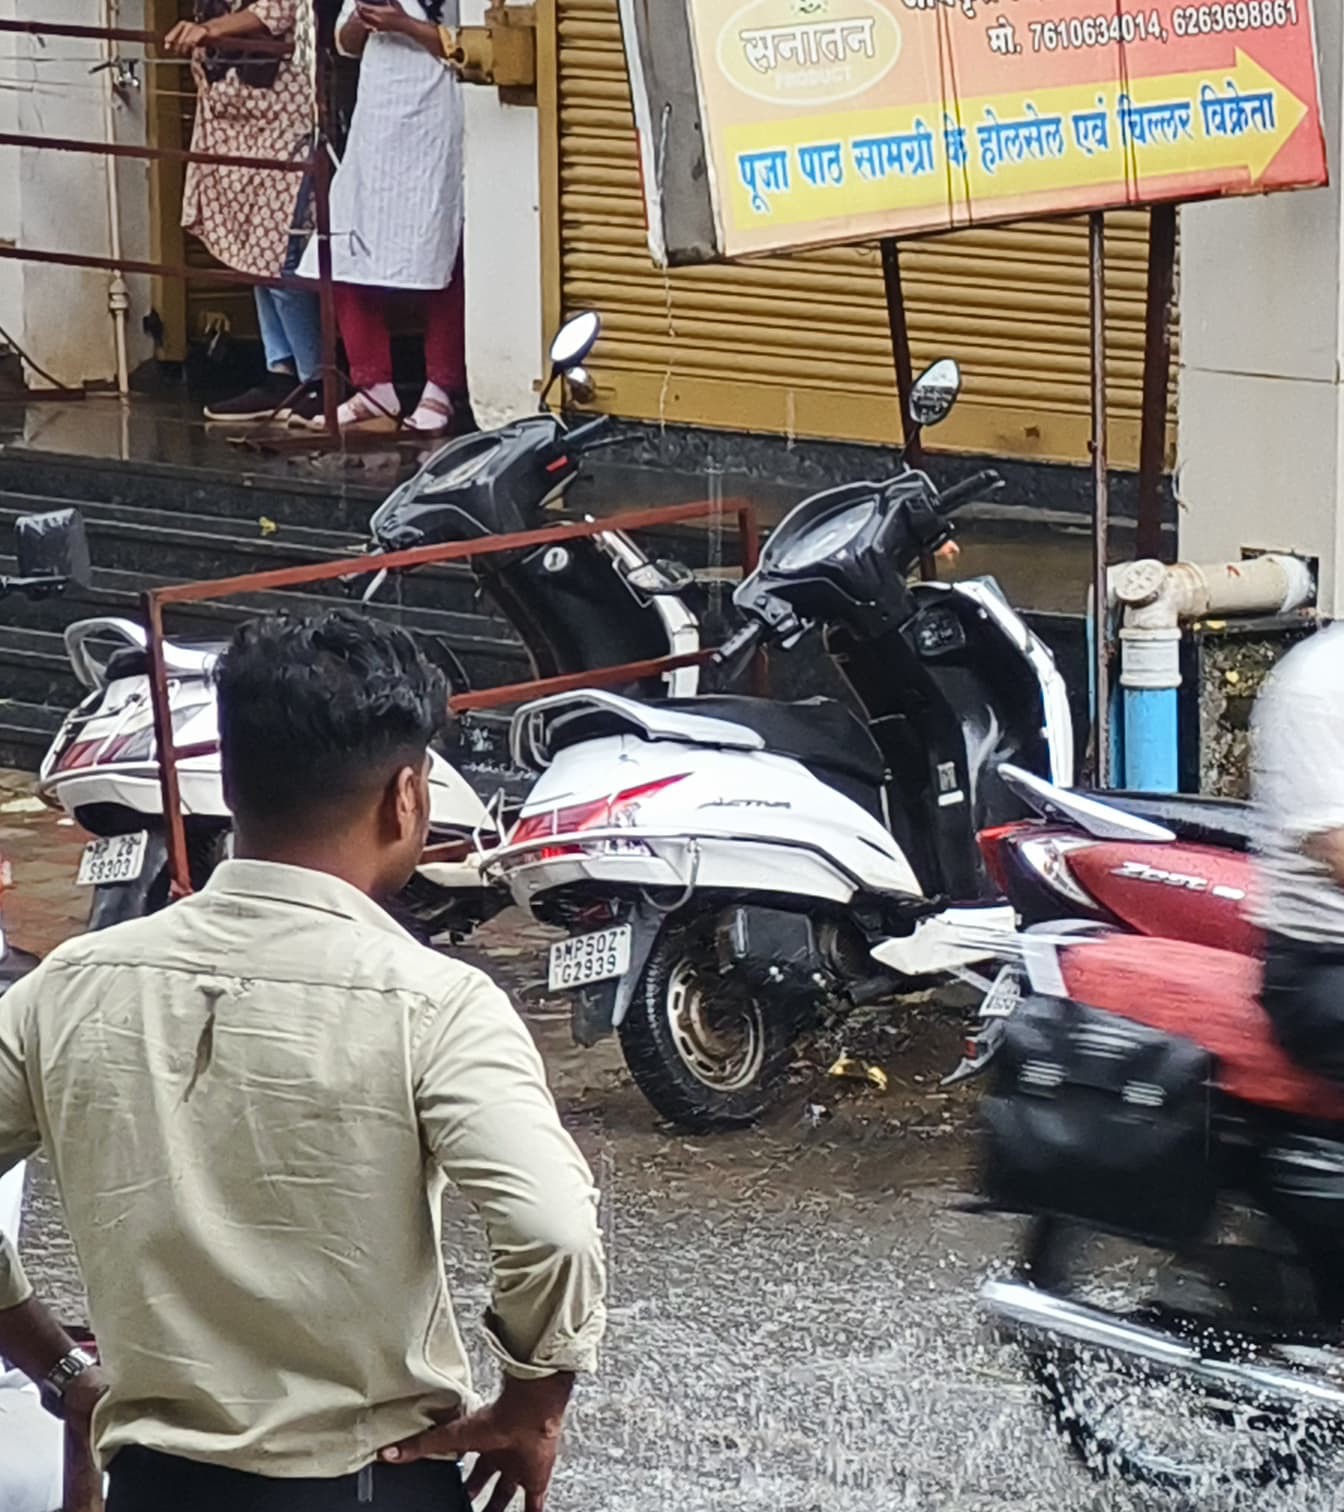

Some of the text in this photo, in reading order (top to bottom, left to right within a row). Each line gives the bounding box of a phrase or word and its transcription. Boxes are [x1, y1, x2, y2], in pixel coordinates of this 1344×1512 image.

[739, 16, 875, 73] सनातन
[1028, 7, 1170, 52] 7610634014,
[1172, 1, 1298, 36] 6263698861
[738, 149, 790, 212] पूजा
[797, 143, 844, 184] पाठ
[851, 116, 935, 180] सामग्री
[944, 111, 968, 169] के
[977, 104, 1065, 174] होलसेल
[1073, 96, 1110, 156] एवं
[1200, 80, 1276, 139] विक्रेता
